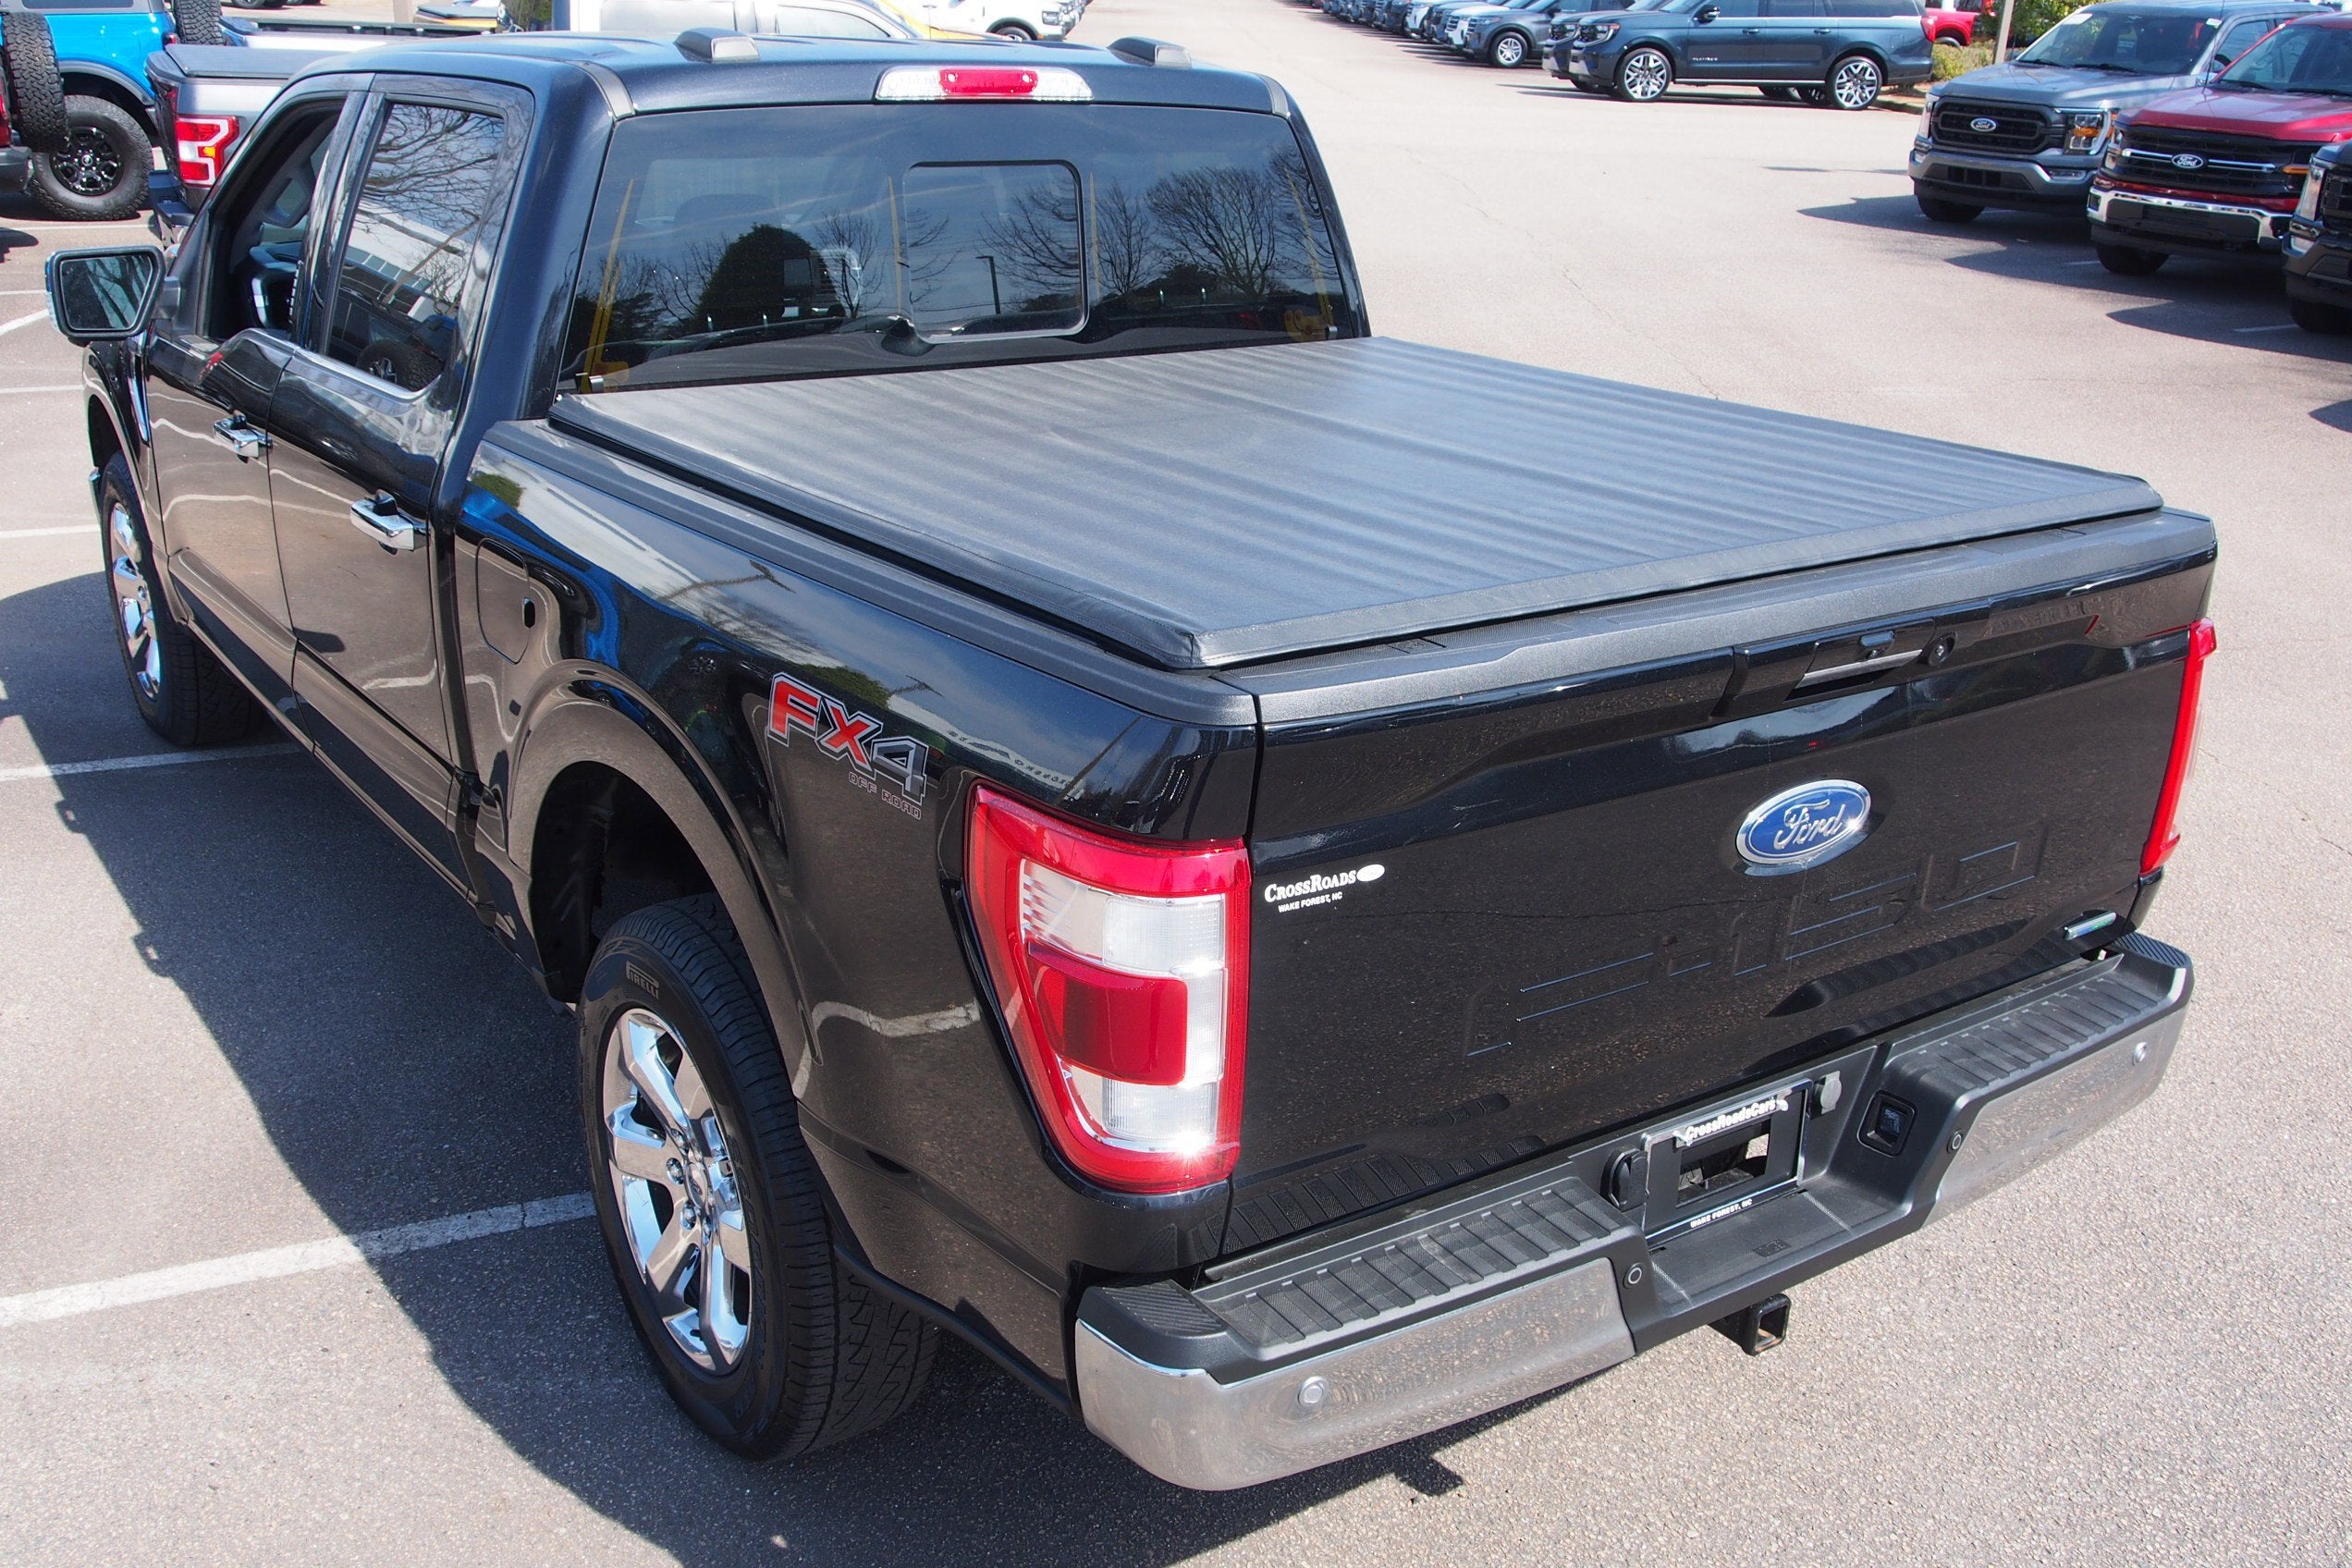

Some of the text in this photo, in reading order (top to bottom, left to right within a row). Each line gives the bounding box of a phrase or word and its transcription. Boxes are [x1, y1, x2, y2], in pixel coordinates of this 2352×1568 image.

[2176, 155, 2199, 166] Ford
[767, 671, 929, 806] FX4
[848, 771, 923, 821] OFF ROAD
[1773, 799, 1846, 851] Ford
[1278, 891, 1343, 913] WAKE FOREST, NC
[1465, 820, 2048, 1057] F-150
[625, 961, 660, 1000] PIRELLI
[1690, 1198, 1753, 1228] WAKE FOREST, NC
